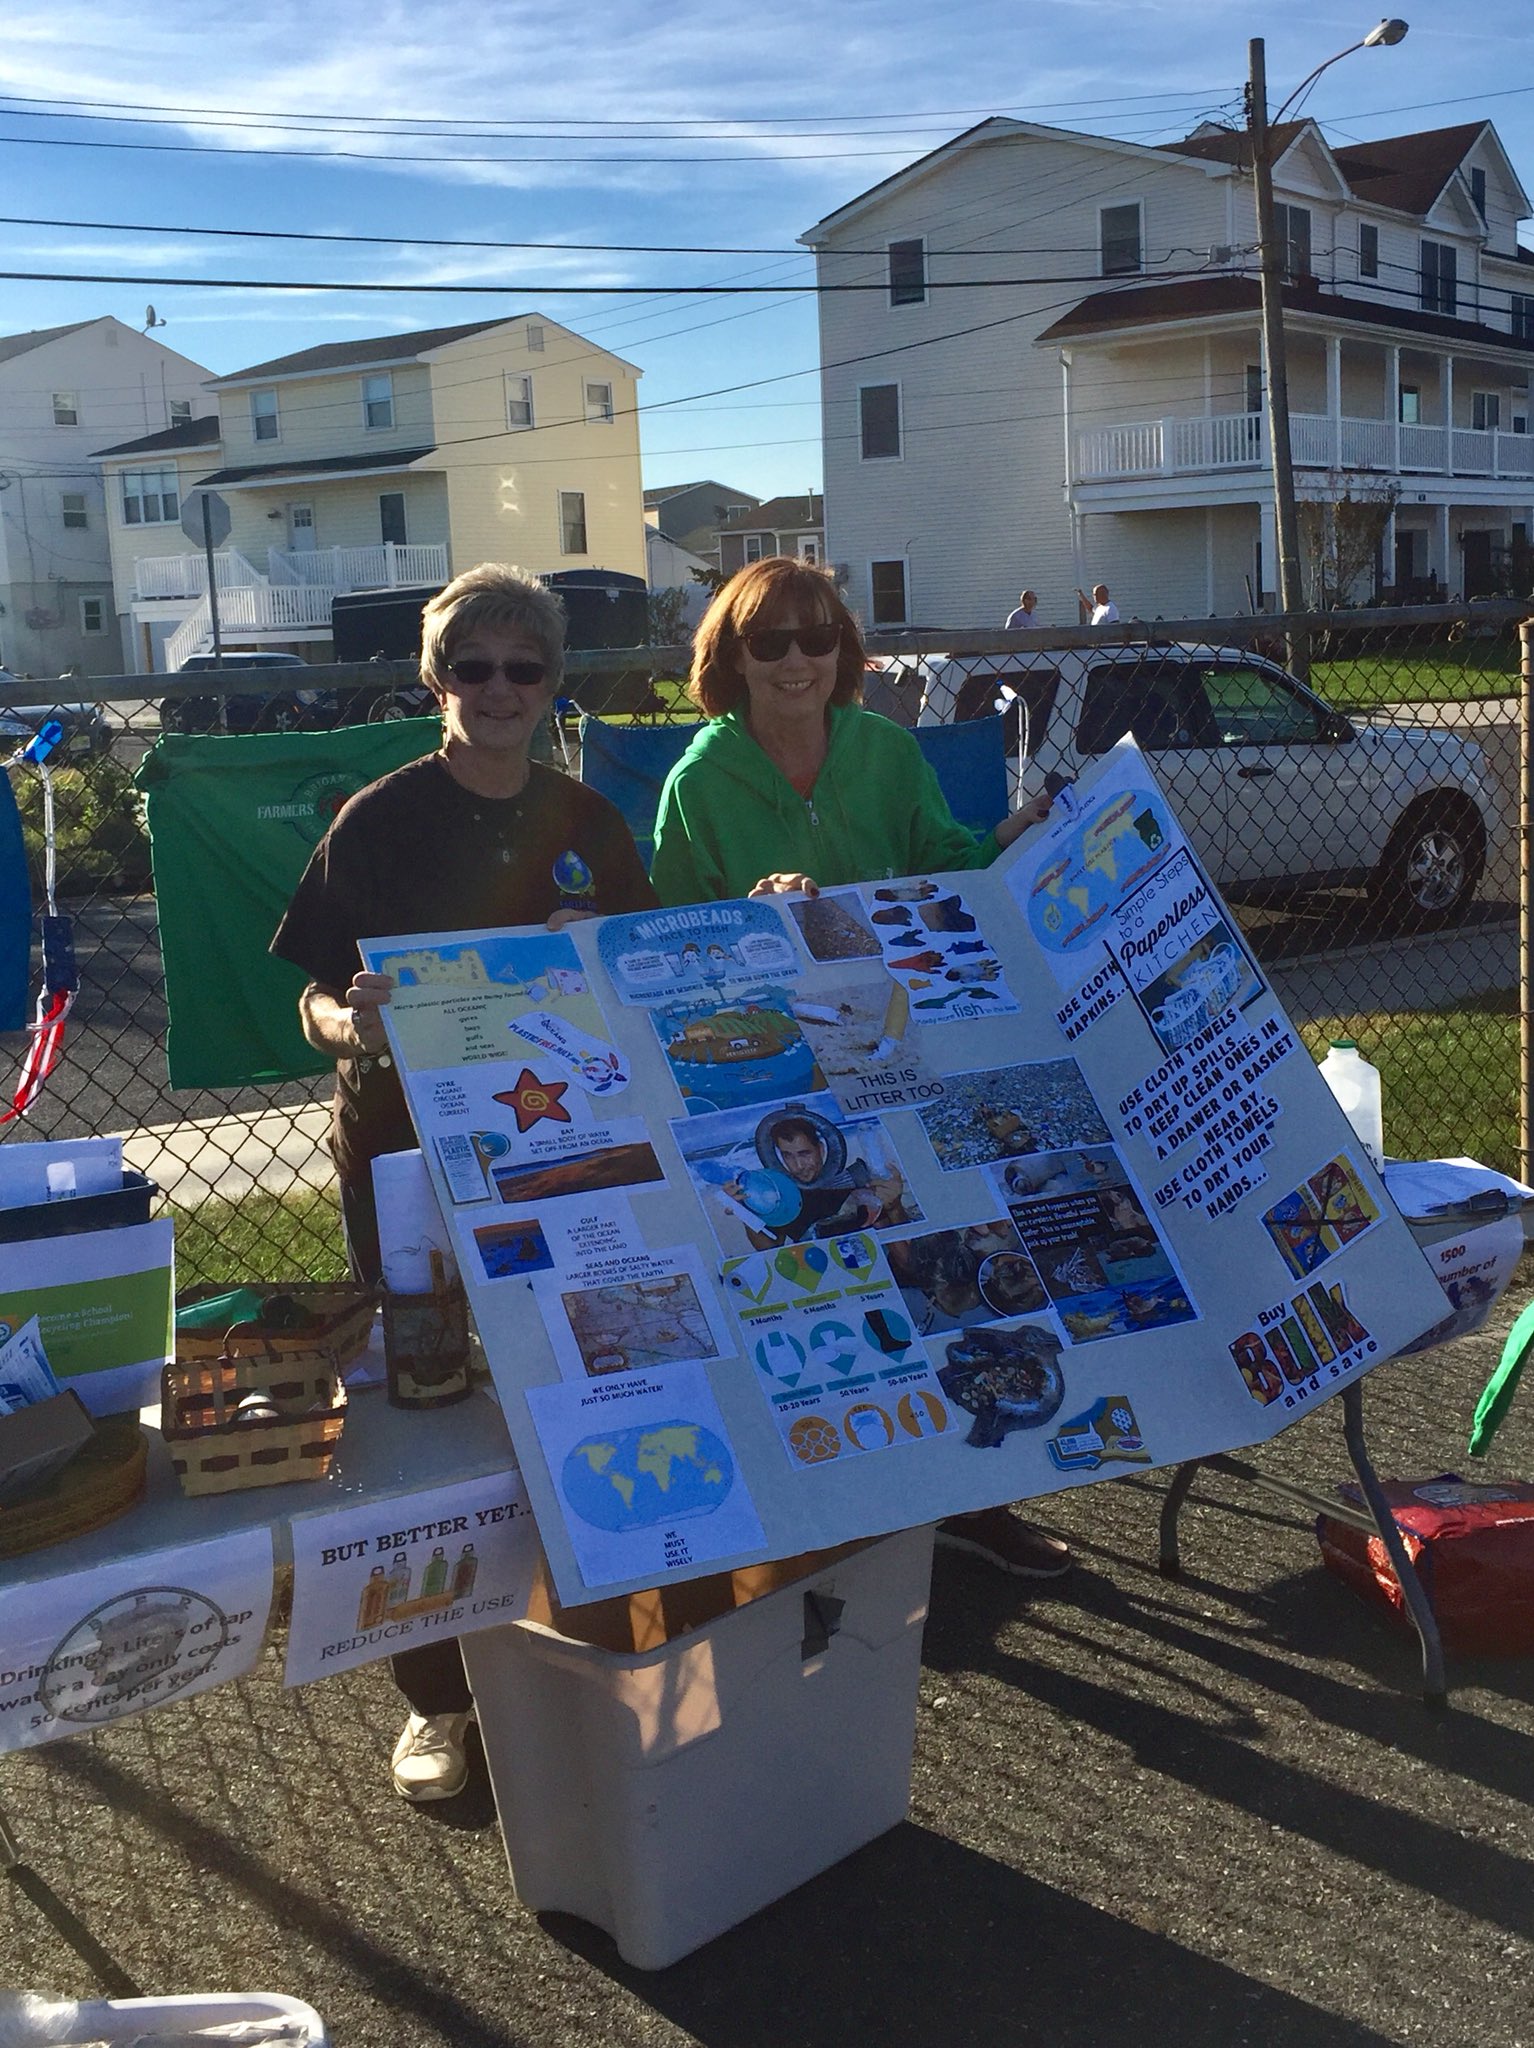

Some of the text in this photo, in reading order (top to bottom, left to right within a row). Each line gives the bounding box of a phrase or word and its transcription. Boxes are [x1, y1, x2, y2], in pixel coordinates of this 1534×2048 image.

[257, 803, 316, 819] FARMERS
[1115, 885, 1157, 926] Simple
[1154, 854, 1191, 890] Steps
[635, 909, 744, 940] MICROBEADS
[689, 927, 701, 938] TO
[1118, 915, 1146, 941] to a
[1119, 884, 1209, 968] Paperless
[1133, 906, 1219, 988] KITCHEN
[1056, 959, 1120, 1025] USE CLOTH
[952, 1003, 985, 1018] fish
[541, 1019, 567, 1045] OCEANS
[461, 1055, 486, 1063] WORLD
[1119, 1008, 1237, 1116] USE CLOTH TOWELS
[856, 1068, 918, 1089] THIS IS
[1148, 1018, 1280, 1139] KEEP CLEAN ONES IN
[433, 1093, 467, 1102] CIRCULAR
[442, 1086, 463, 1094] GIANT
[845, 1082, 945, 1111] LITTER TOO
[1156, 1033, 1294, 1161] A DRAWER OR BASKET
[438, 1107, 470, 1118] CURRENT
[441, 1101, 465, 1109] OCEAN
[1123, 1116, 1143, 1137] TO
[1143, 1091, 1170, 1121] DRY
[1171, 1075, 1189, 1097] UP
[1202, 1090, 1266, 1147] NEAR BY.
[534, 1137, 556, 1146] SMALL
[557, 1134, 576, 1143] BODY
[559, 1142, 579, 1151] FROM
[591, 1138, 614, 1146] OCEAN
[1154, 1097, 1279, 1206] USE CLOTH TOWELS
[1182, 1132, 1271, 1210] TO DRY YOUR
[1206, 1172, 1267, 1219] HANDS...
[573, 1223, 599, 1233] LARGER
[580, 1216, 598, 1224] GULF
[571, 1229, 621, 1242] OF THE OCEAN
[579, 1237, 617, 1249] EXTENDING
[575, 1249, 593, 1257] INTO
[609, 1242, 628, 1251] LAND
[1440, 1244, 1467, 1264] 1500
[565, 1271, 592, 1281] LARGER
[592, 1267, 618, 1276] BODIES
[628, 1262, 649, 1271] SALTY
[649, 1259, 675, 1267] WATER
[585, 1255, 650, 1269] SEAS AND OCEANS
[1482, 1255, 1498, 1271] of
[582, 1269, 664, 1287] THAT COVER THE EARTH
[867, 1292, 885, 1301] Years
[809, 1302, 837, 1314] Months
[1257, 1302, 1287, 1327] Buy
[757, 1314, 783, 1325] Months
[909, 1371, 929, 1383] Years
[1284, 1339, 1378, 1408] and save
[592, 1379, 648, 1394] WE ONLY HAVE
[839, 1385, 870, 1398] 50 Years
[580, 1384, 664, 1407] JUST SO MUCH WATER!
[778, 1396, 822, 1412] 10-20 Years
[321, 1540, 368, 1567] BUT
[376, 1516, 469, 1554] BETTER
[664, 1530, 677, 1539] WE
[664, 1538, 685, 1549] MUST
[664, 1547, 689, 1558] USE IT
[665, 1555, 693, 1568] WISELY
[320, 1593, 515, 1661] REDUCE THE USE
[0, 1651, 99, 1687] Drinking
[190, 1614, 214, 1636] of
[220, 1610, 253, 1629] tap
[0, 1635, 242, 1712] water a only costs
[30, 1712, 55, 1730] 50
[62, 1692, 122, 1717] cents
[125, 1680, 165, 1702] per
